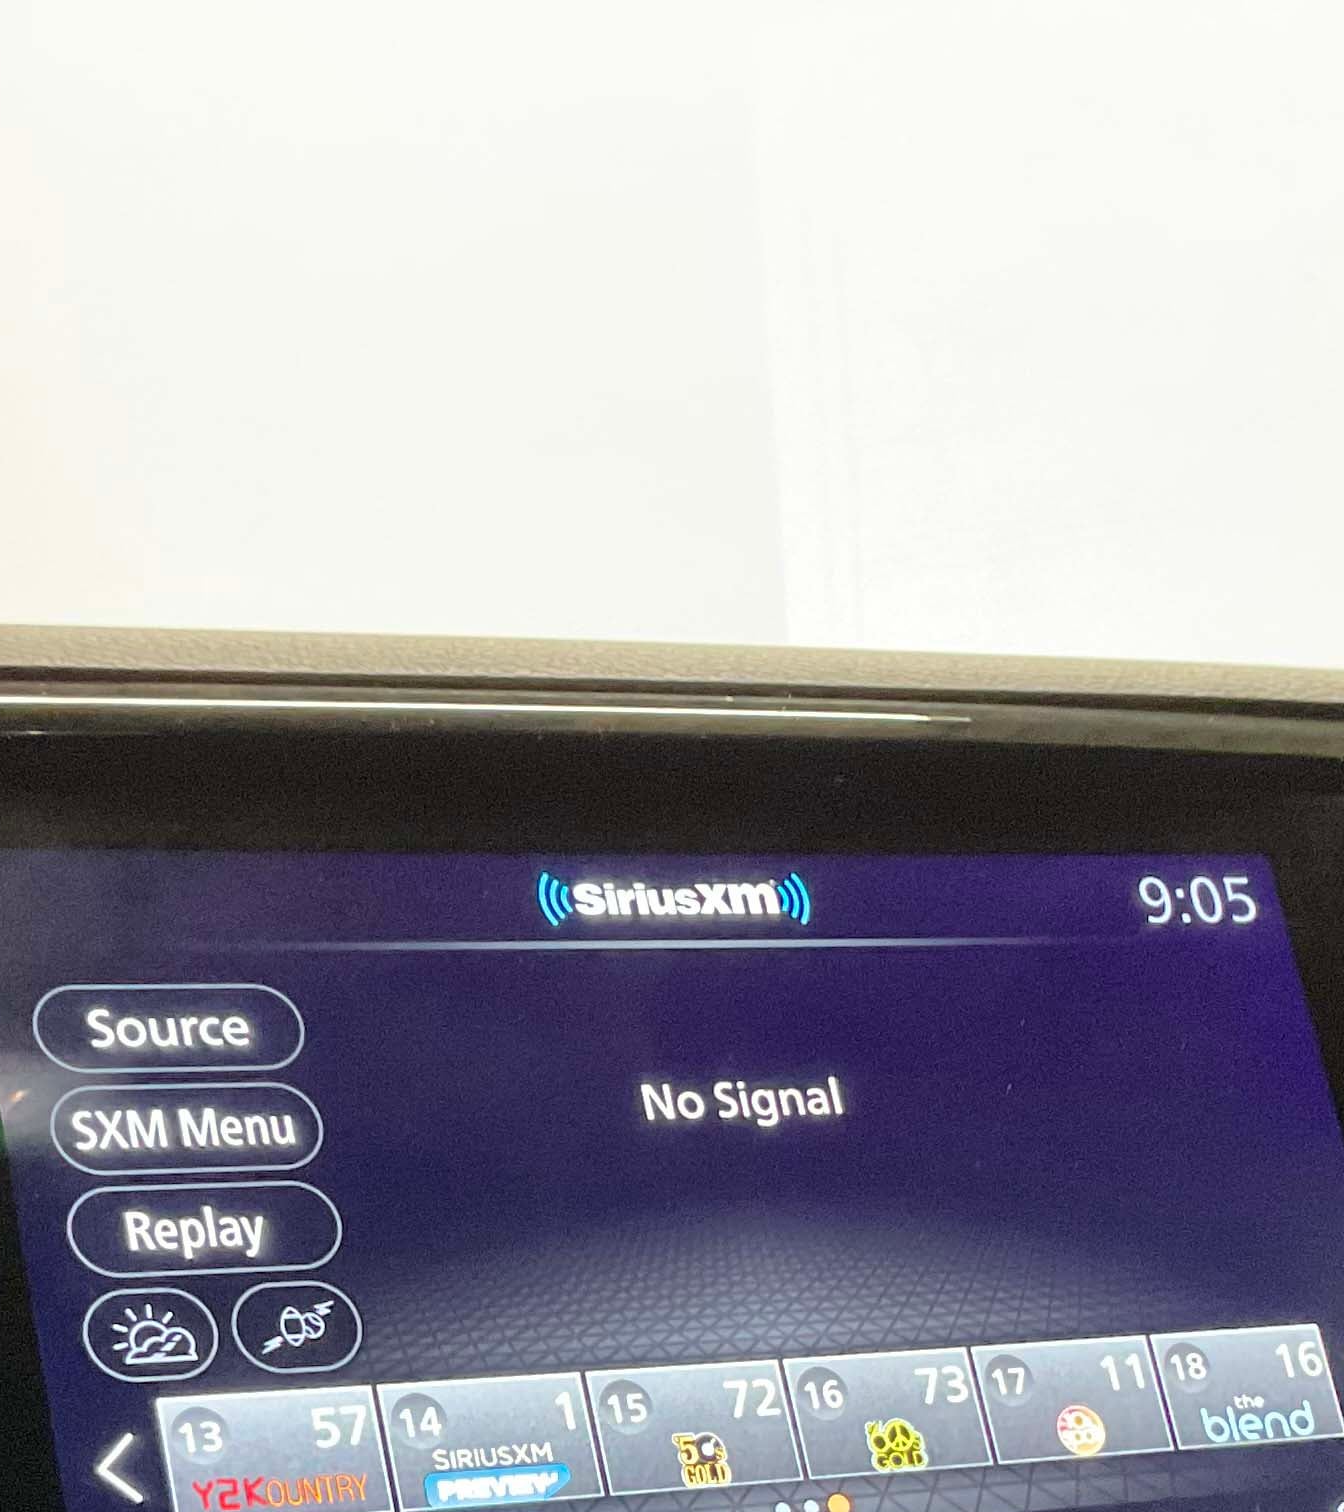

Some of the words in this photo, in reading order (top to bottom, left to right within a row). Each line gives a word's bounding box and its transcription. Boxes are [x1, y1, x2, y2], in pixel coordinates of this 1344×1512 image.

[1138, 876, 1257, 923] 9:05
[86, 1009, 250, 1050] Source
[640, 1082, 706, 1121] No
[713, 1077, 844, 1127] Signal
[71, 1109, 168, 1153] SXM
[180, 1108, 297, 1150] Menu
[125, 1206, 265, 1260] Replay
[1100, 1352, 1147, 1392] 11
[1170, 1353, 1207, 1382] 18
[1276, 1341, 1323, 1379] 16
[723, 1379, 778, 1418] 72
[805, 1379, 844, 1410] 16
[914, 1365, 970, 1405] 73
[992, 1366, 1026, 1396] 17
[556, 1393, 576, 1431] 1
[607, 1391, 648, 1426] 15
[1233, 1394, 1264, 1409] the
[179, 1419, 224, 1454] 13
[312, 1405, 367, 1449] 57
[398, 1405, 443, 1441] 14
[1200, 1399, 1316, 1443] blend
[432, 1441, 554, 1471] SIRIUSXM
[683, 1462, 731, 1487] GOLD
[874, 1450, 927, 1472] GOLD
[192, 1474, 368, 1511] Y2KOUNTRY
